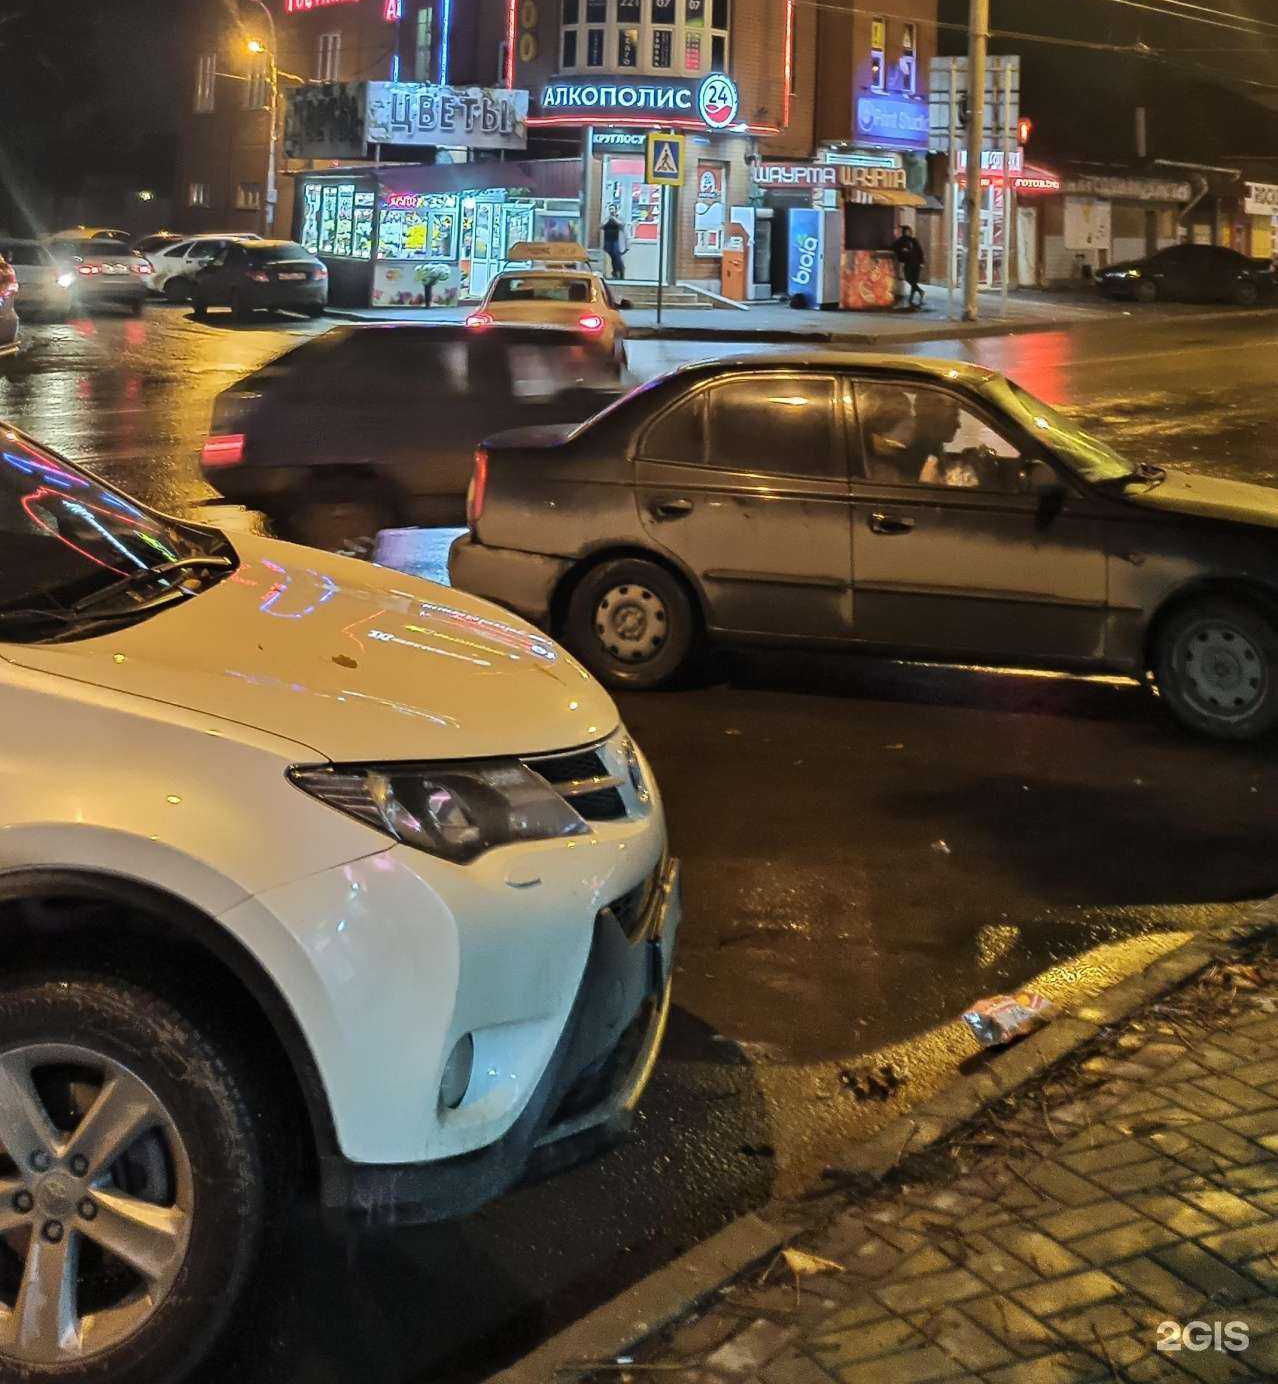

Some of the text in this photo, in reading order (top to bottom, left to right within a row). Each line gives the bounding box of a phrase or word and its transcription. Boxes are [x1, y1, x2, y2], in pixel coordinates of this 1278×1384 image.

[688, 0, 700, 10] 07
[543, 86, 692, 109] АЛКОПОЛИС
[708, 85, 728, 104] 24
[391, 93, 513, 137] ЦВЕТЫ
[792, 236, 818, 285] biola
